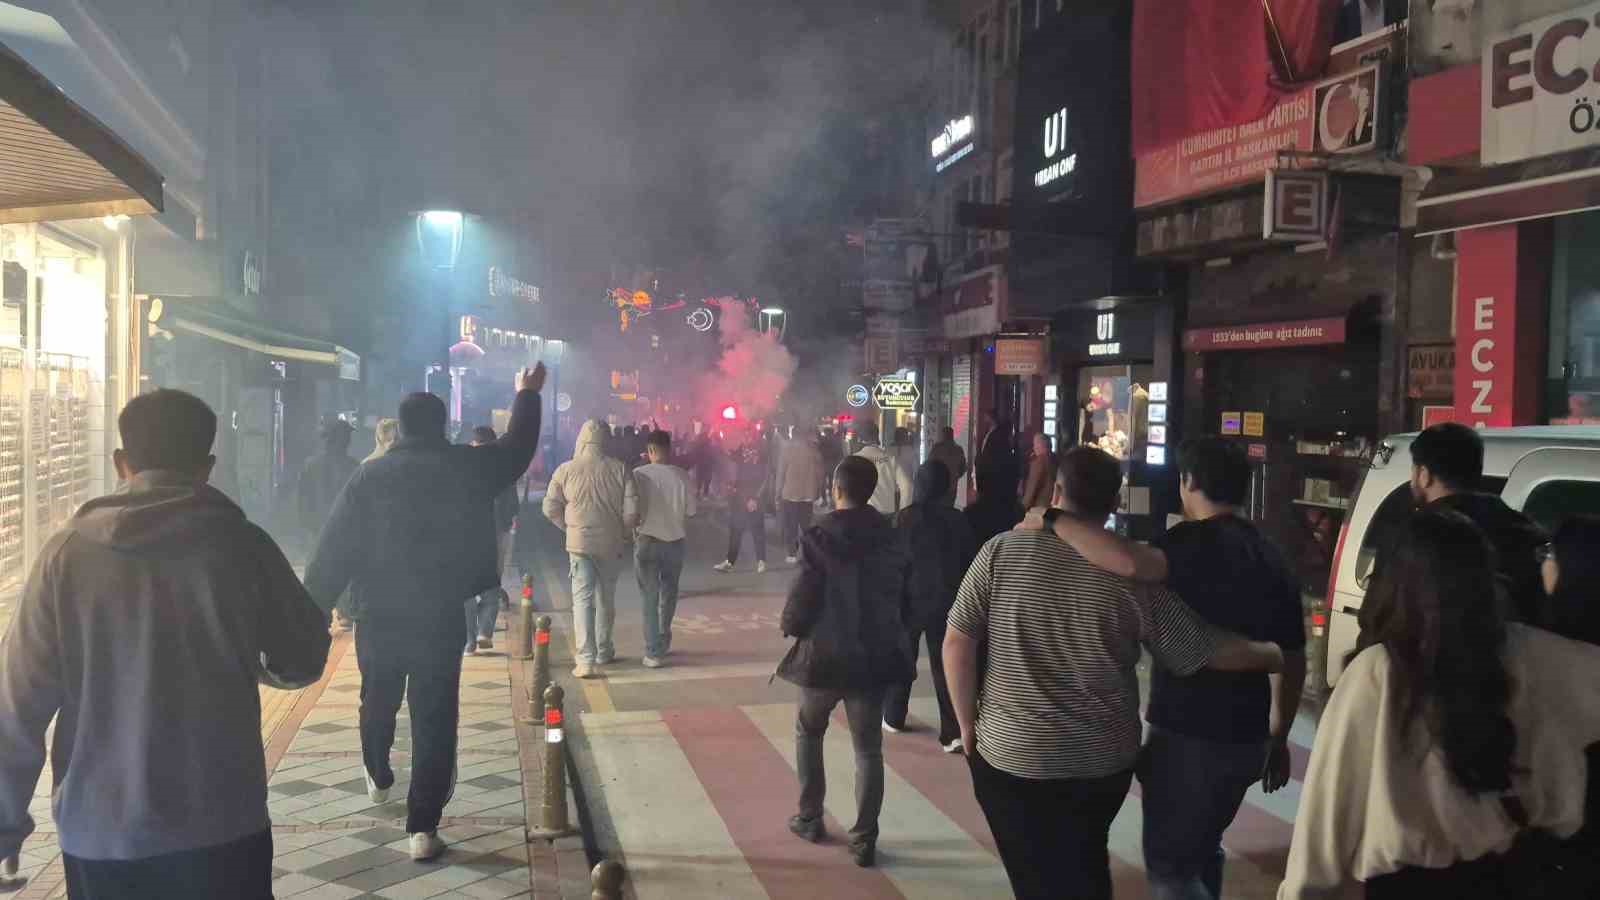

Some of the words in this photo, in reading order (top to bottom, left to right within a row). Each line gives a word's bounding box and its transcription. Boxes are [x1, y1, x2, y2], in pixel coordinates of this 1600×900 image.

[1492, 11, 1600, 109] EC
[1044, 106, 1067, 158] U1
[1569, 97, 1600, 134] Ö
[1096, 313, 1114, 340] U1
